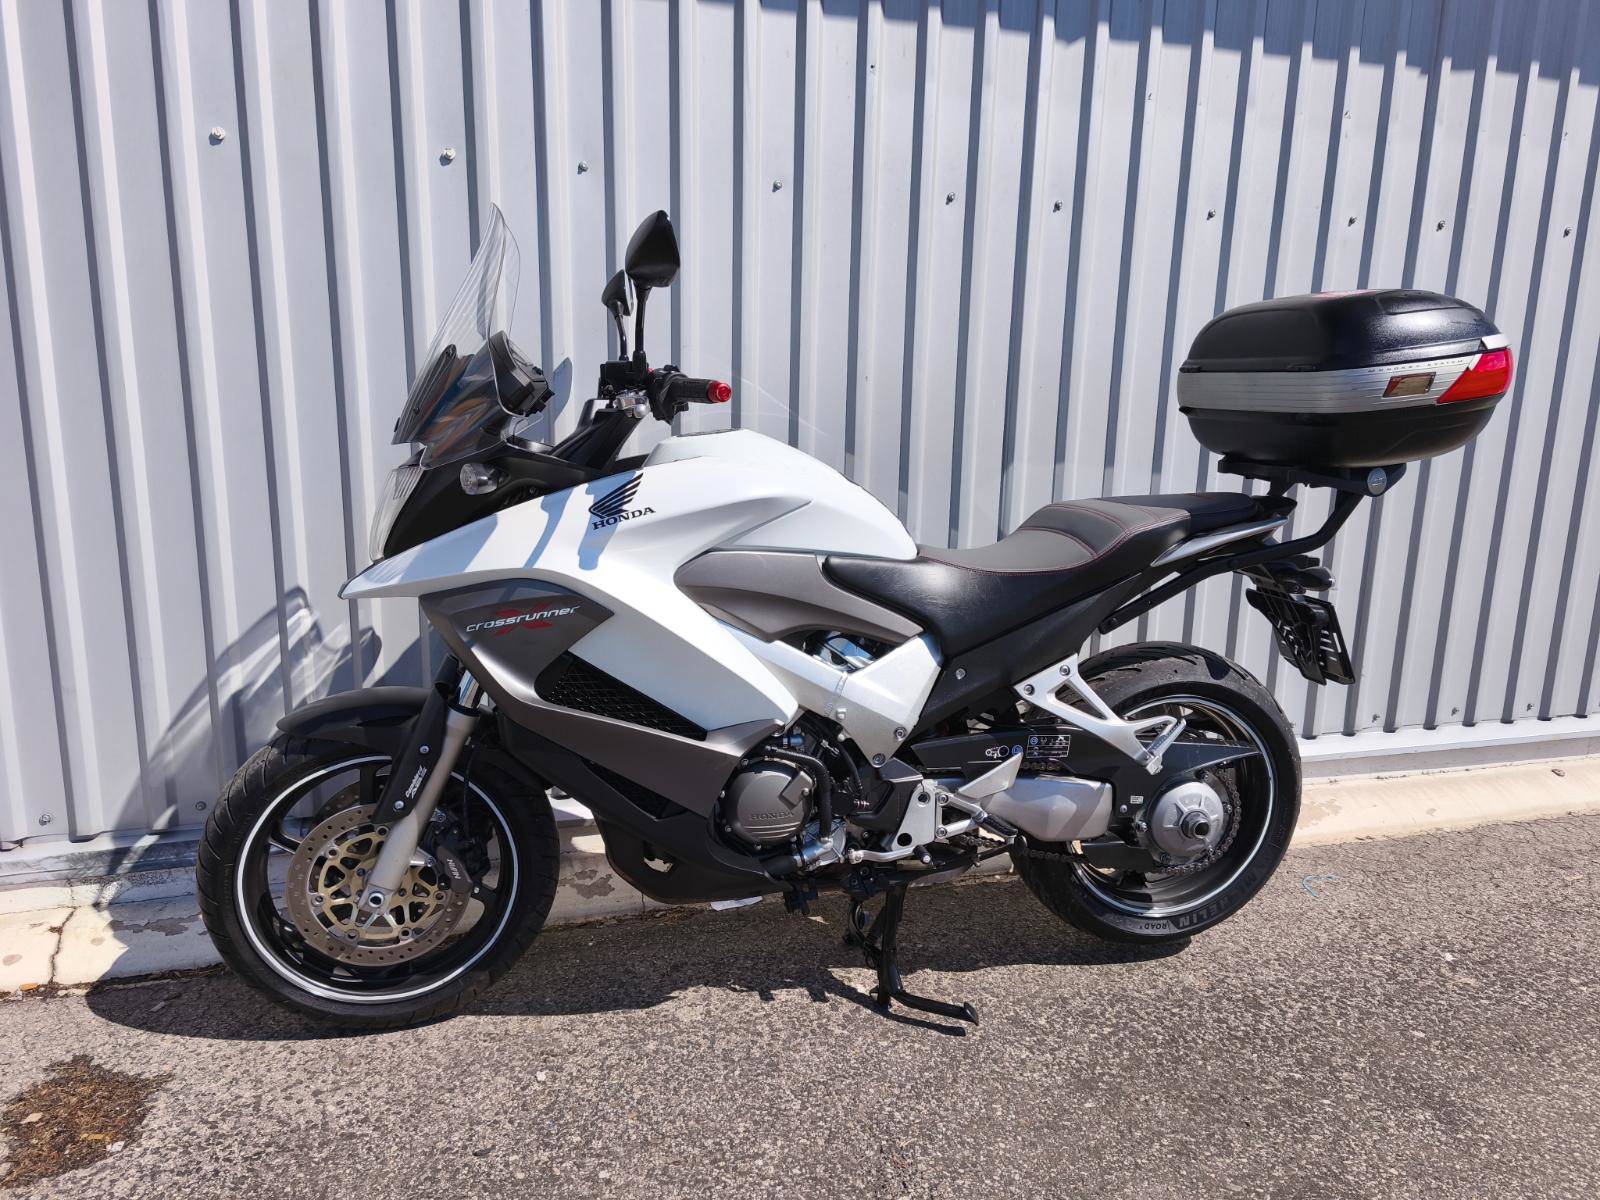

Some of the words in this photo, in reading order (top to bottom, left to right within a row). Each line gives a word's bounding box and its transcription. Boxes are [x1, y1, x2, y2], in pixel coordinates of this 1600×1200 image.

[591, 506, 656, 530] HONDA
[466, 605, 580, 632] crossrunner
[751, 811, 795, 820] HONDA
[1144, 922, 1168, 930] ROAD
